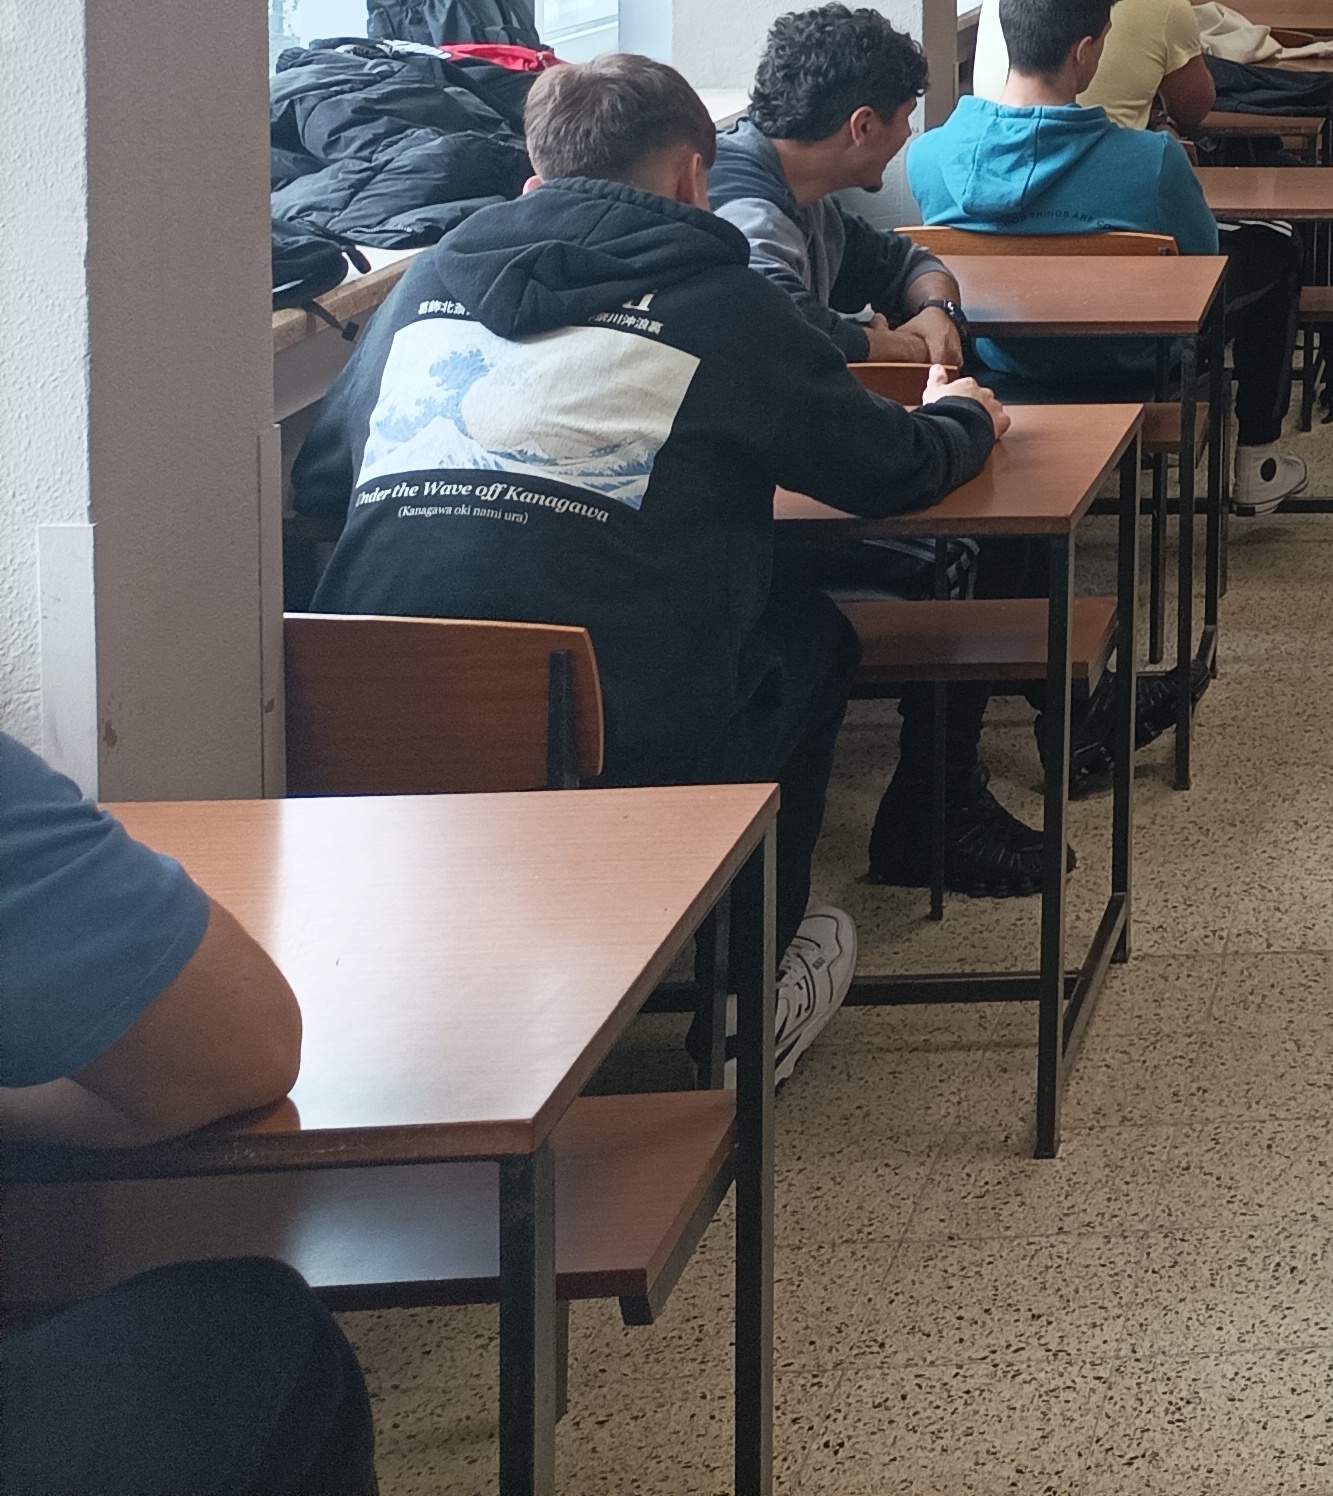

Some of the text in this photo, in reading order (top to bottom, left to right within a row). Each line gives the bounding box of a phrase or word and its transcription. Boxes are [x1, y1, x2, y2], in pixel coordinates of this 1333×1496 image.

[391, 482, 420, 499] the
[422, 481, 473, 497] Wave
[474, 482, 506, 501] off
[503, 485, 609, 523] Kanagawa
[397, 504, 529, 525] (Kanagawa oki nami ura)
